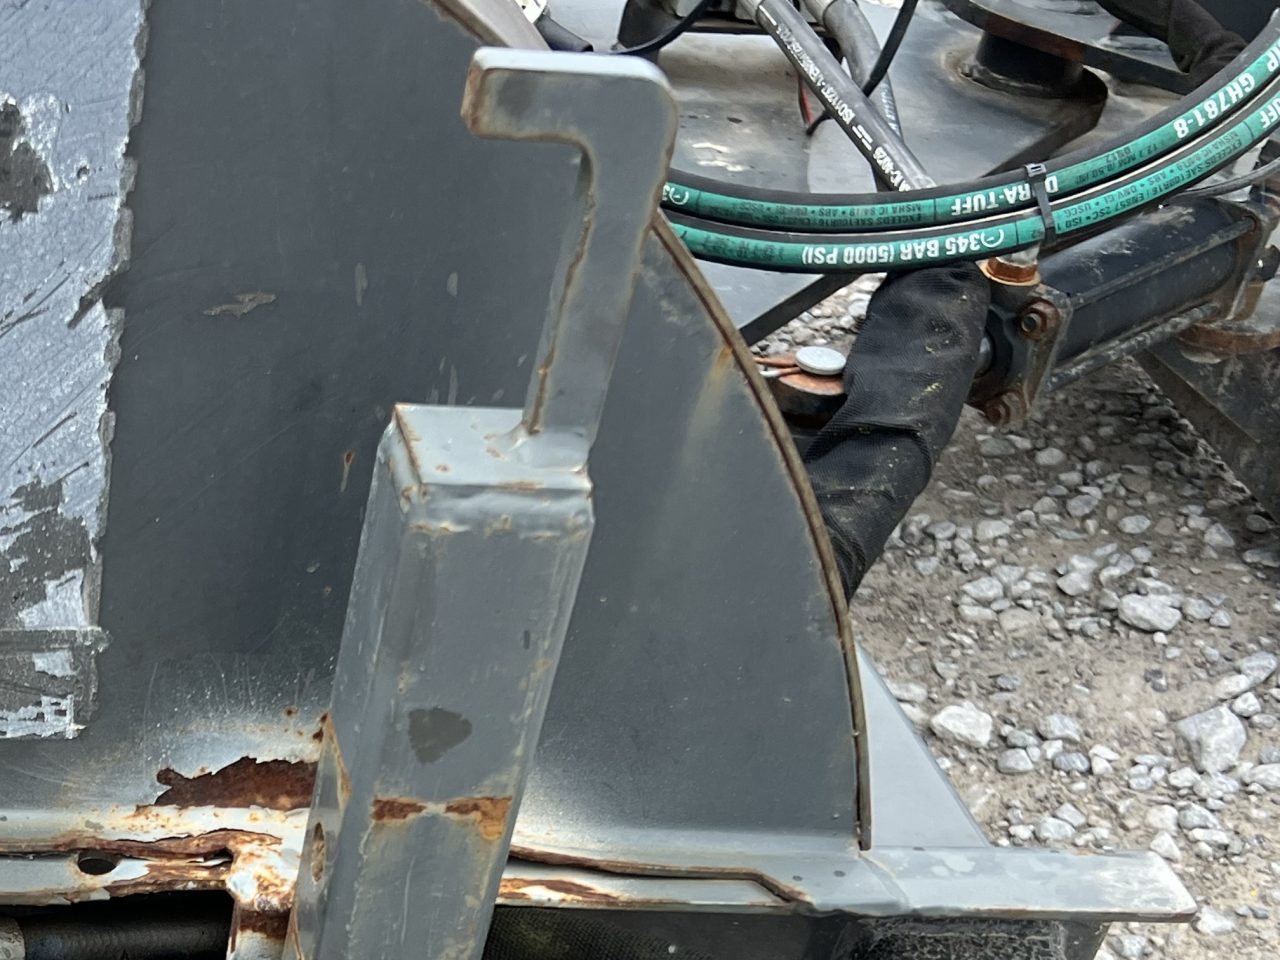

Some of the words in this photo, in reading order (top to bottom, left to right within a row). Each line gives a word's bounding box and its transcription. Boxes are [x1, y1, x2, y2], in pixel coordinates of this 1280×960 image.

[1173, 73, 1255, 138] GH781-8
[951, 176, 1058, 216] DRA-TUFF
[843, 244, 894, 264] (5000
[899, 239, 939, 260] BAR
[945, 233, 981, 255] 345
[801, 246, 837, 264] PSI)
